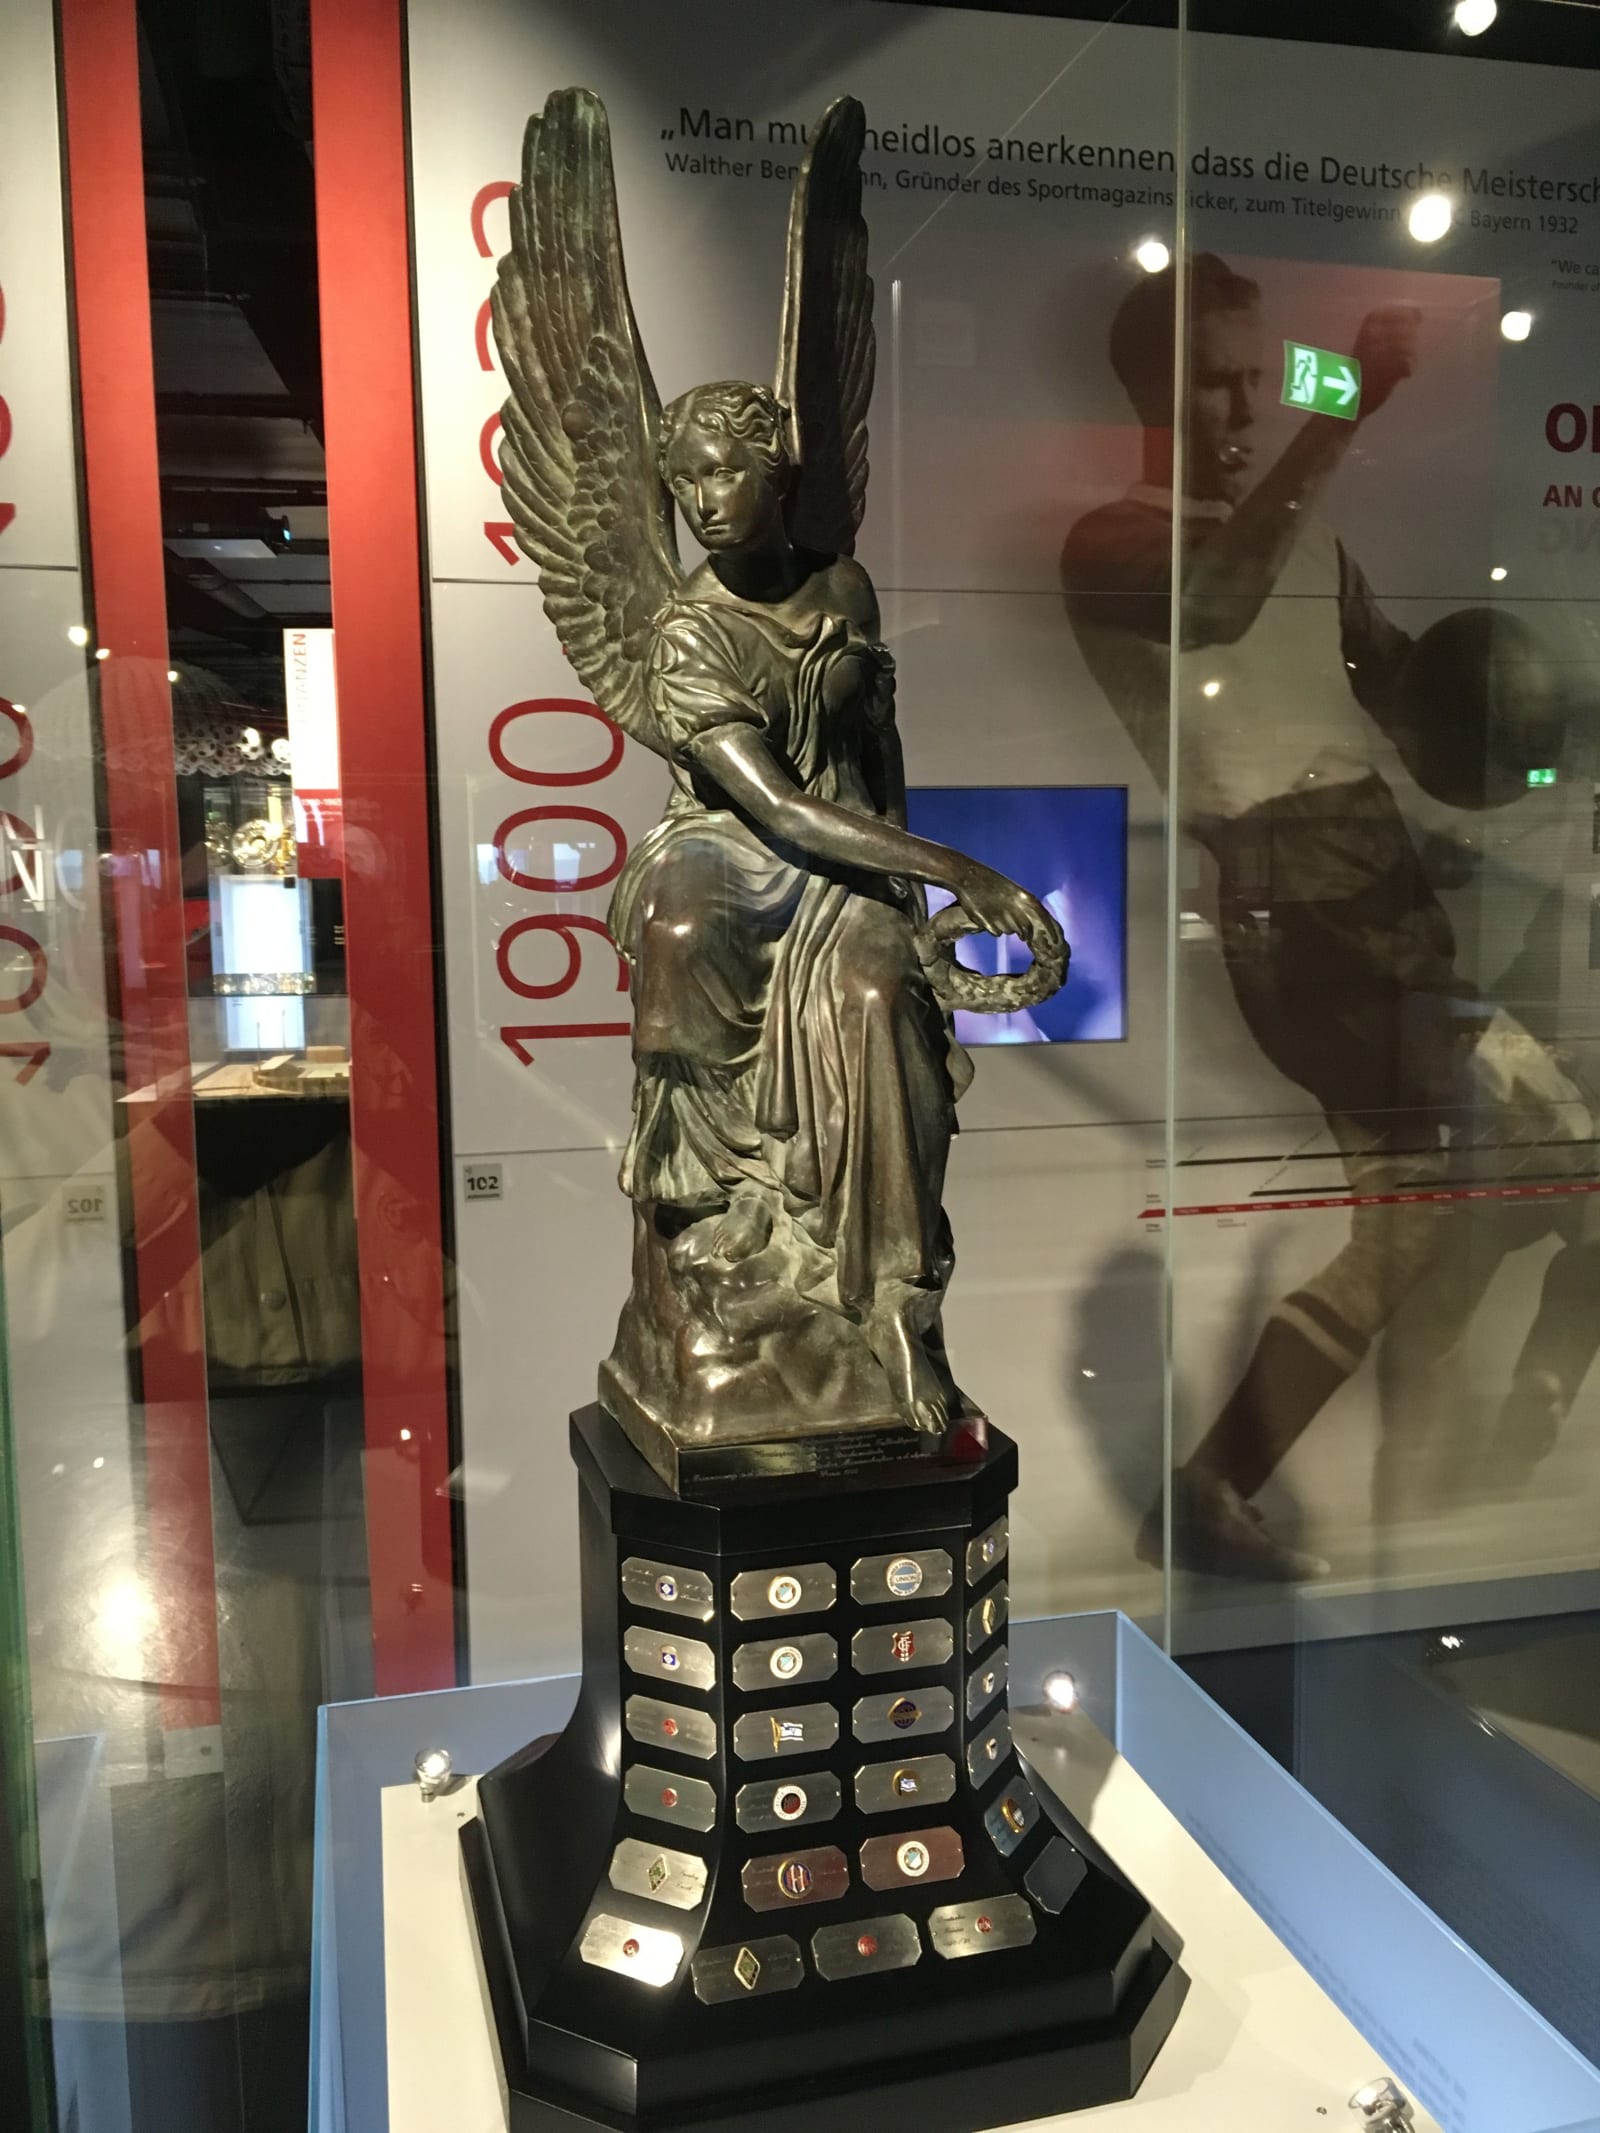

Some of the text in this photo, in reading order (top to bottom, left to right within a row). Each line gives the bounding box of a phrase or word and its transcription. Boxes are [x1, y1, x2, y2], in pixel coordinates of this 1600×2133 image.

[987, 135, 1175, 172] anerkennen
[1191, 146, 1254, 178] dass
[1264, 152, 1309, 183] die
[1321, 157, 1450, 193] Deutsche
[665, 153, 753, 177] Walther
[896, 169, 981, 194] Gründer
[988, 176, 1021, 197] des
[1028, 179, 1174, 208] Sportmagazins
[1185, 188, 1238, 214] icker,
[1245, 197, 1285, 214] zum
[1471, 209, 1531, 234] Bayern
[1538, 215, 1578, 235] 1932
[1543, 484, 1583, 508] AN
[488, 698, 632, 1067] 1900
[467, 1176, 499, 1191] 102
